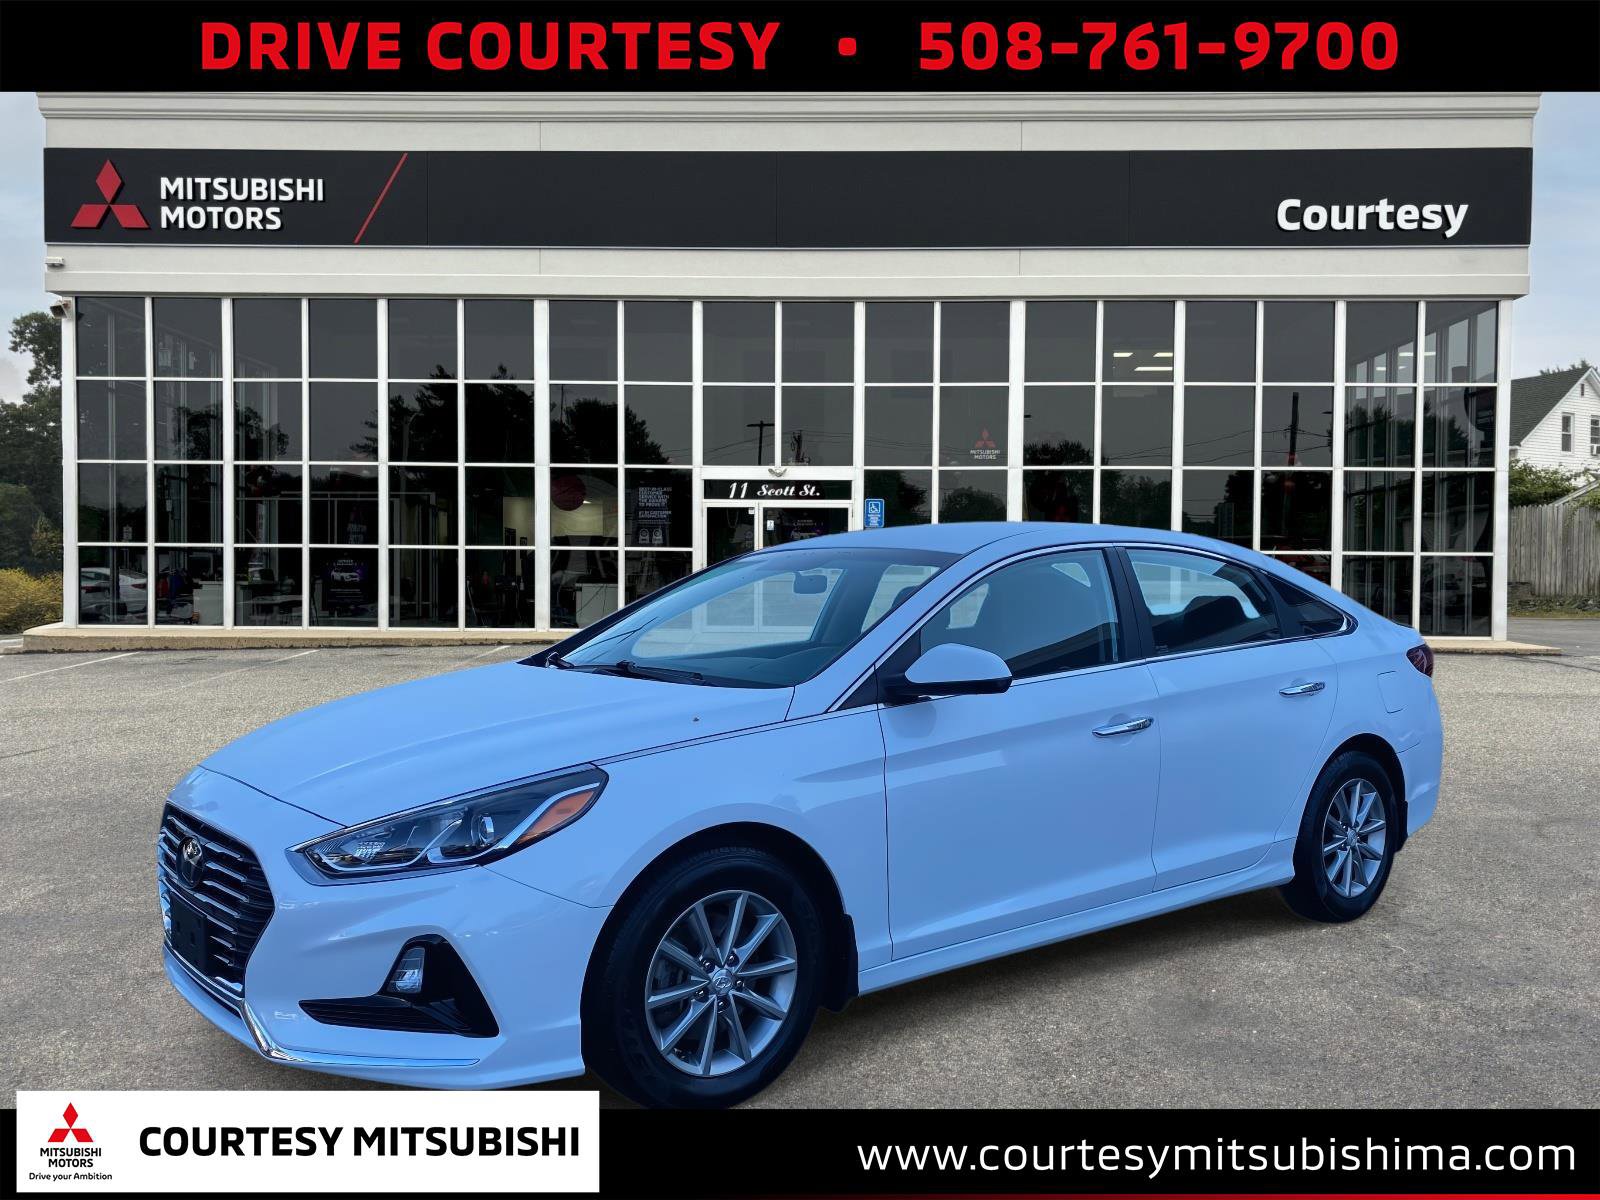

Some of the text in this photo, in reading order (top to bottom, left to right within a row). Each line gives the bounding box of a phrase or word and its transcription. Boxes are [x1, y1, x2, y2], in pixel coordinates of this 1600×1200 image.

[160, 177, 324, 201] MITSUBISHI
[160, 206, 282, 231] MOTORS
[1277, 198, 1469, 238] Courtesy
[729, 482, 820, 499] 11 Scott St.
